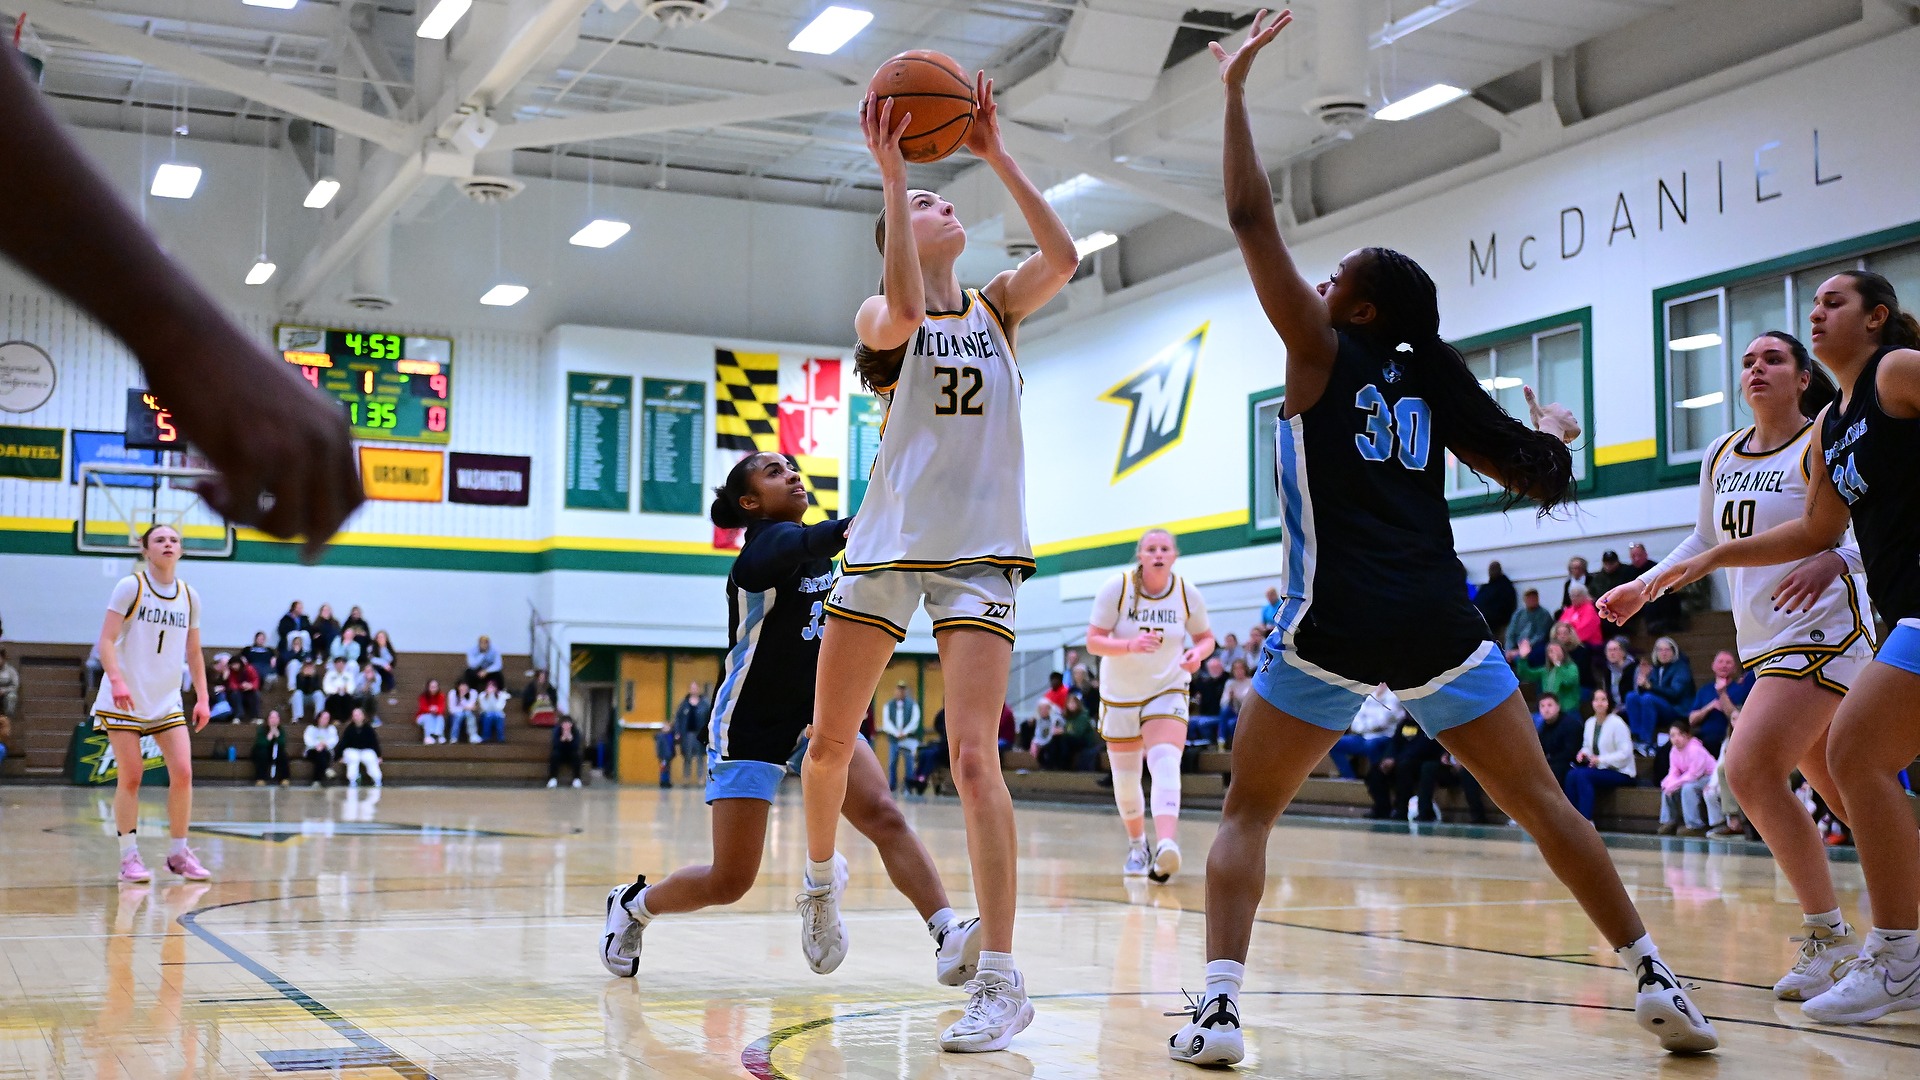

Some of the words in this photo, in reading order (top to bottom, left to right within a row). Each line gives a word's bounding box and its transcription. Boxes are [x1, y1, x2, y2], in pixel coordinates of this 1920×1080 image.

[1470, 129, 1842, 286] McDANIEL
[345, 332, 401, 360] 4:53
[363, 369, 374, 395] 1
[429, 374, 448, 399] 9
[934, 366, 984, 416] 32
[156, 411, 177, 442] 5
[428, 405, 447, 432] 0
[1355, 384, 1432, 472] 30
[1721, 499, 1757, 540] 40
[137, 605, 188, 629] McDANIEL
[156, 630, 165, 654] 1
